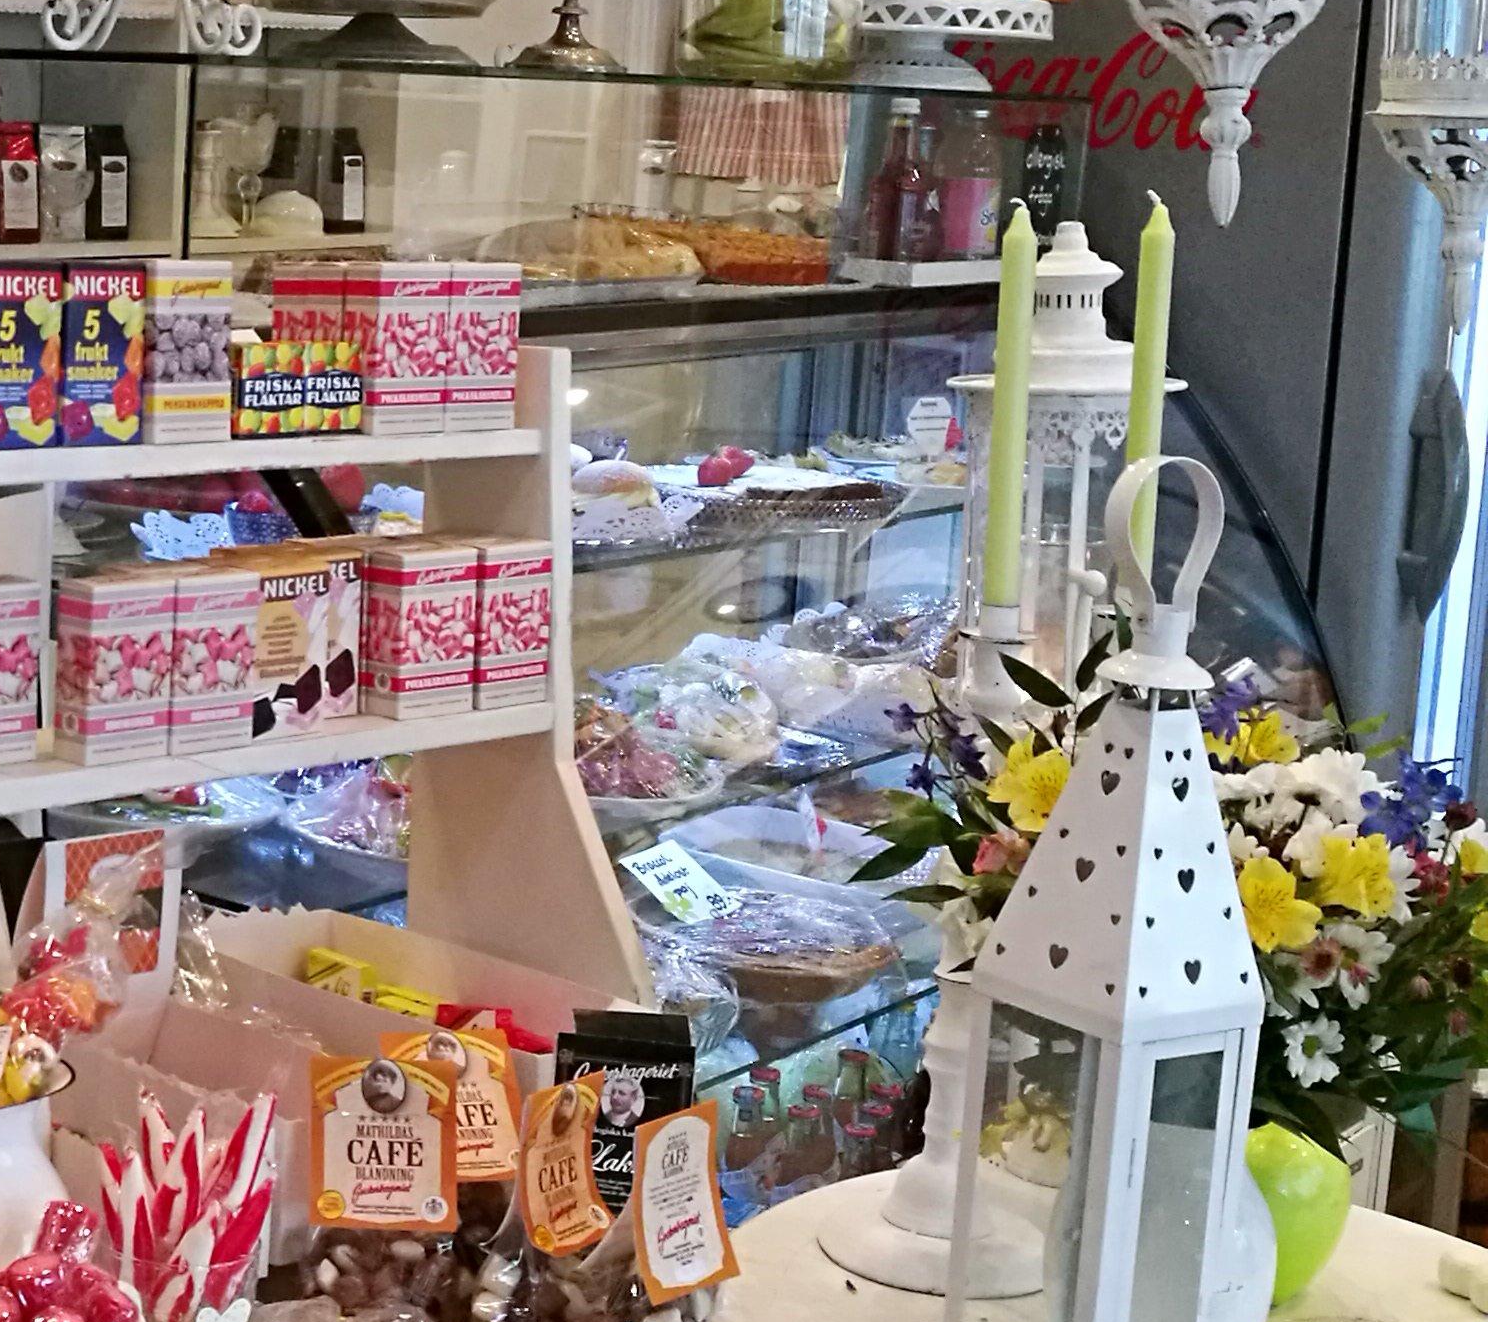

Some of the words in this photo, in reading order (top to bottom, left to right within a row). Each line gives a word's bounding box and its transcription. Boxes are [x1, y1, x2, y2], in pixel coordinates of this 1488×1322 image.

[73, 274, 142, 298] NICKEL
[82, 309, 102, 341] 5
[74, 341, 110, 364] frukt
[66, 362, 121, 384] smaker
[306, 375, 361, 392] FRISKA
[244, 378, 303, 393] FRISKA
[305, 388, 361, 405] FLÄKTAR
[243, 390, 303, 408] FLÄKTAR
[263, 574, 328, 599] NICKEL
[456, 1099, 498, 1126] AFÉ
[346, 1137, 424, 1168] CAFÉ
[591, 1138, 635, 1175] Lak
[355, 1166, 415, 1182] BLANDNING
